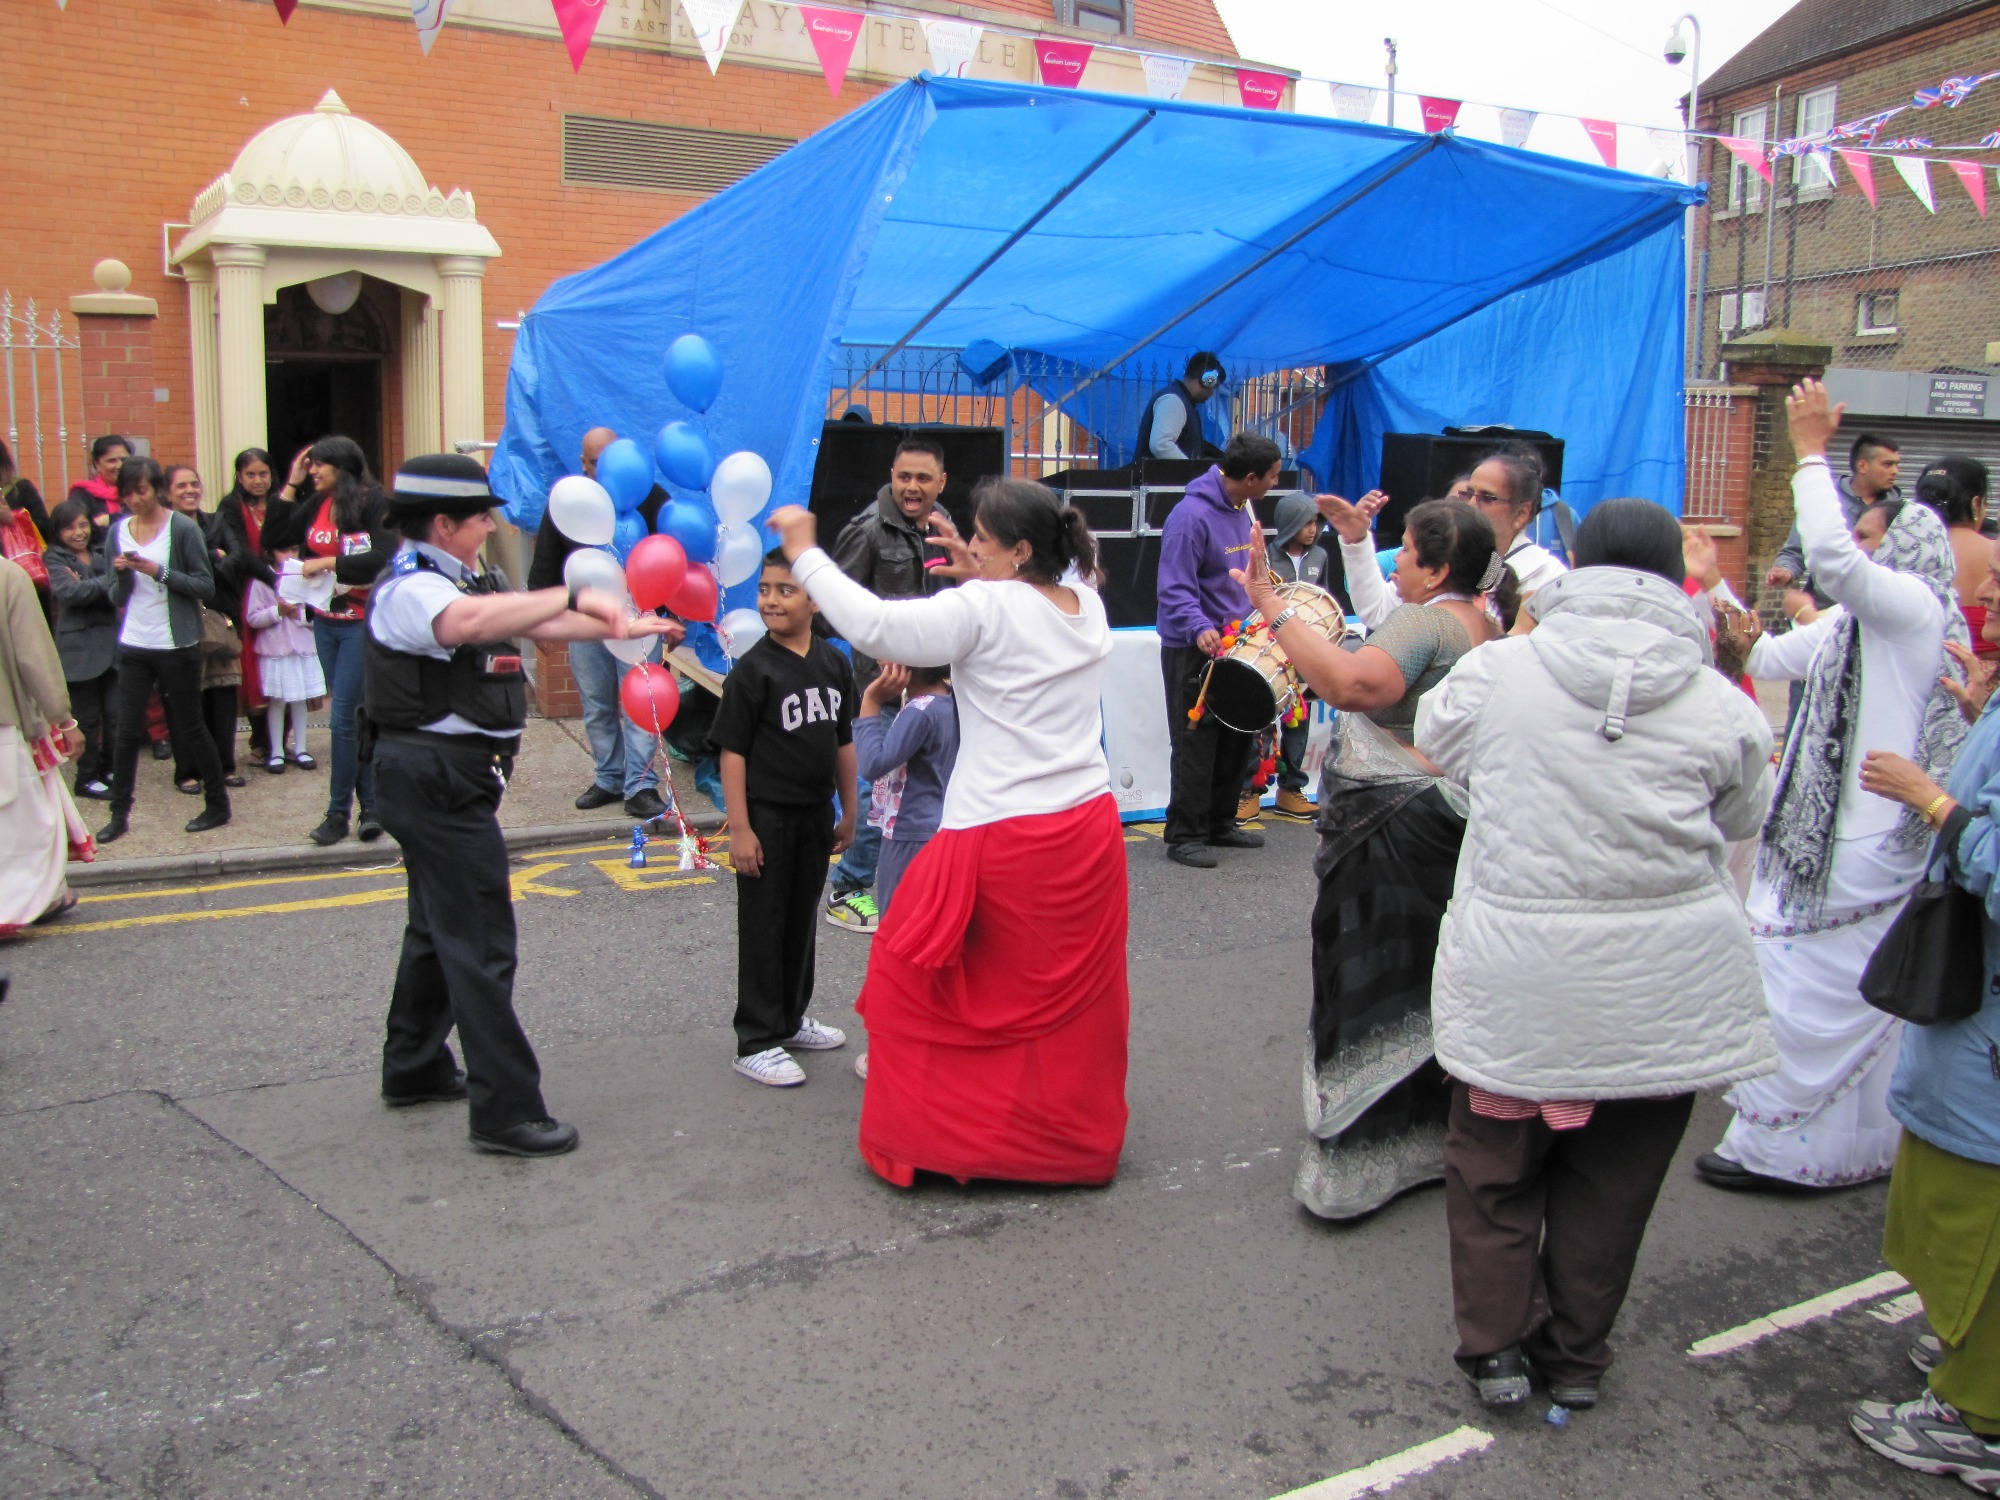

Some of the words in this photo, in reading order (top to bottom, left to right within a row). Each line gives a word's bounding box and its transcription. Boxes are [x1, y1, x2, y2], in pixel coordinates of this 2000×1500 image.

[621, 16, 668, 35] EAST
[874, 21, 1016, 68] TELE
[1935, 381, 1946, 390] NO
[1950, 382, 1981, 391] PARKING
[781, 687, 842, 732] GAP
